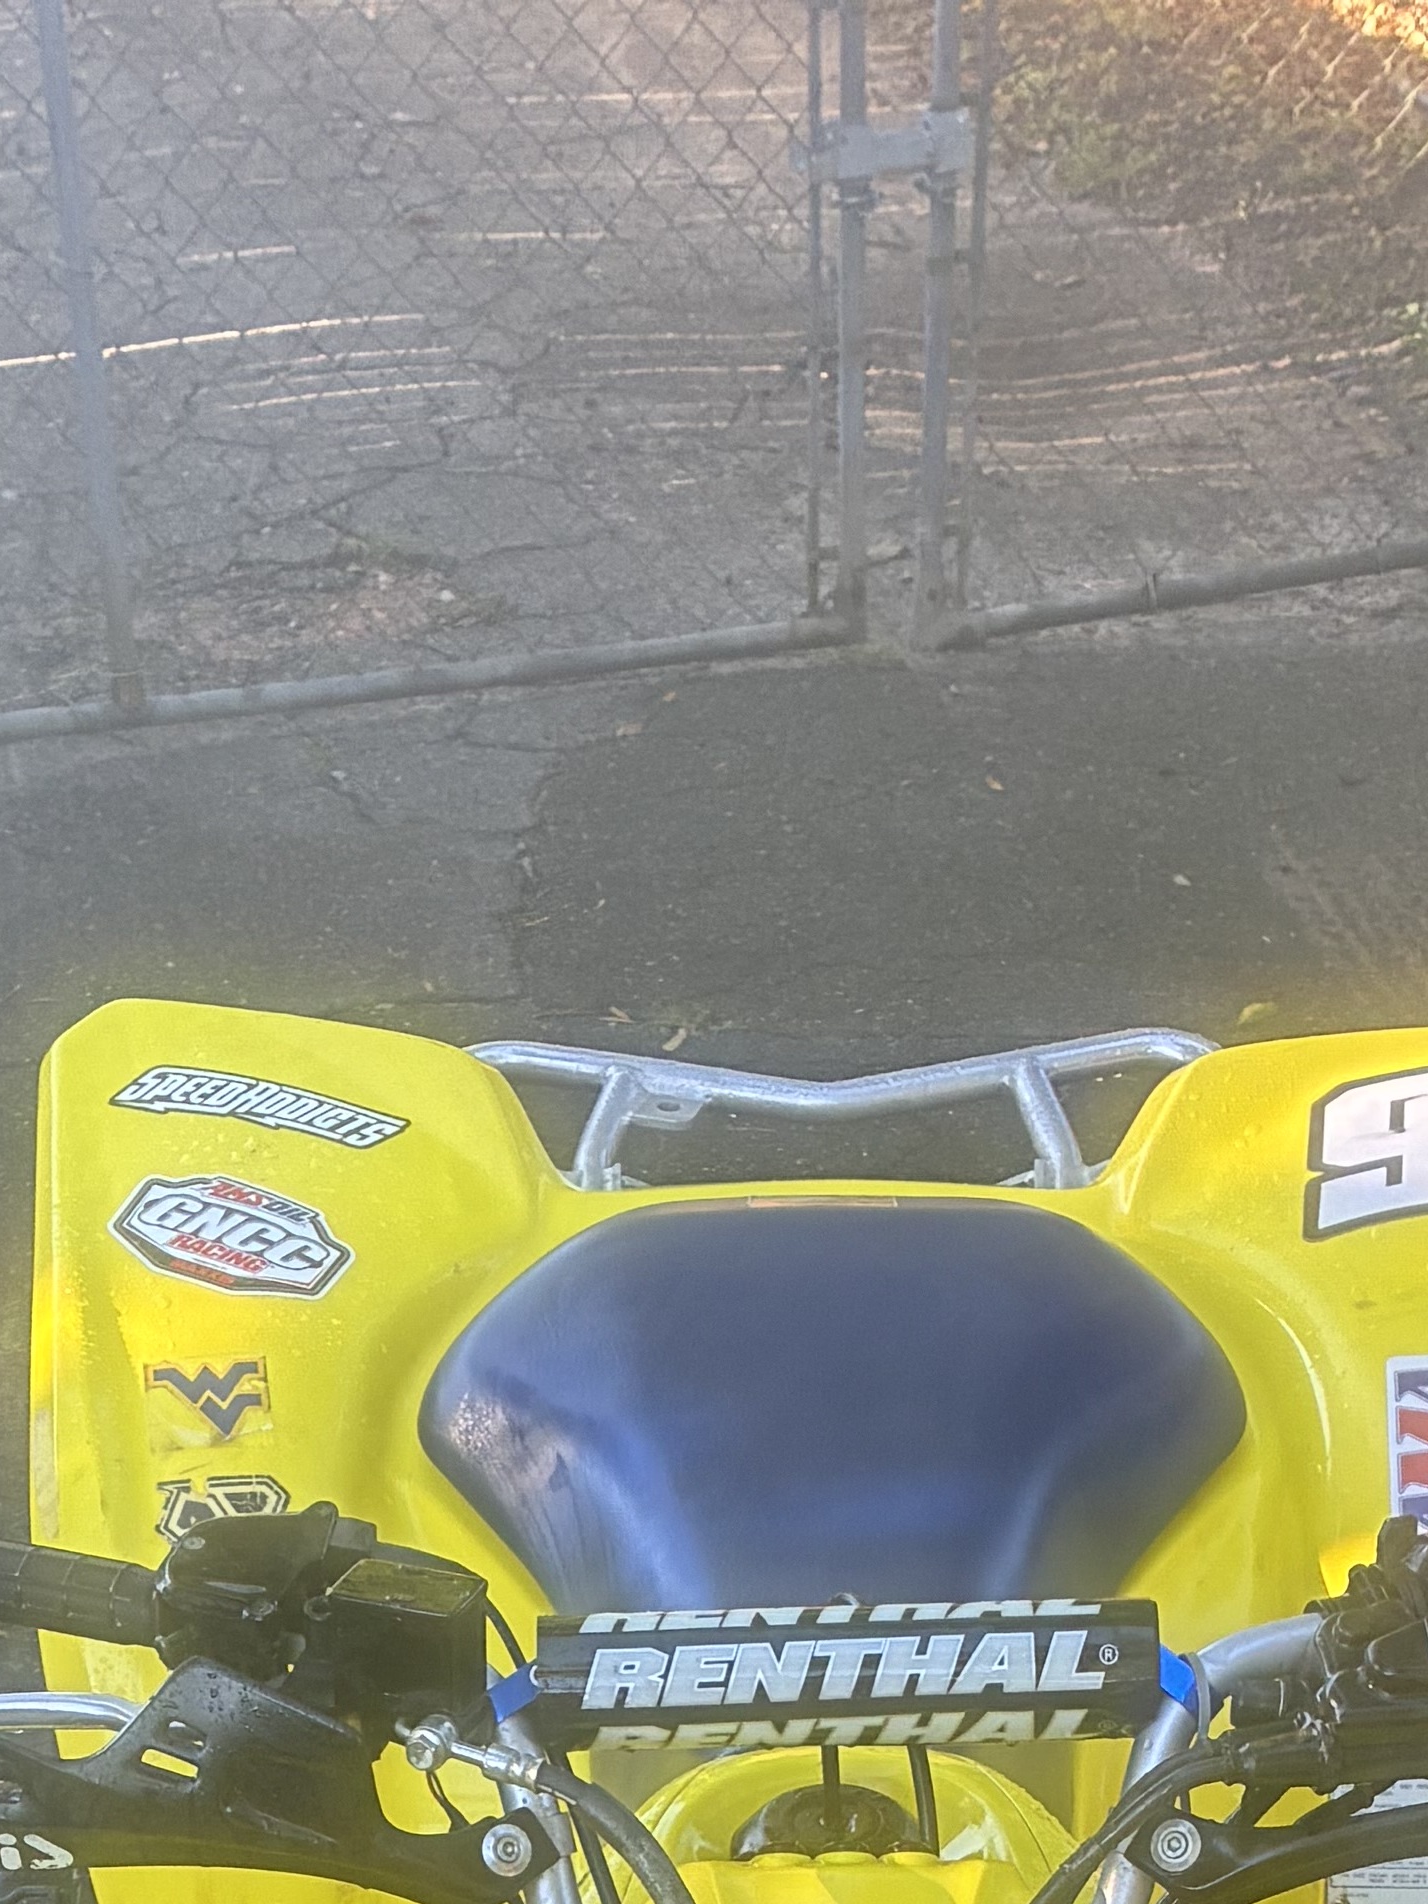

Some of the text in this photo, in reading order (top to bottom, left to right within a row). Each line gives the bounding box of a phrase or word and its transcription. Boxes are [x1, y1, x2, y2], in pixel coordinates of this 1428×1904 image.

[139, 1194, 331, 1270] GNCC
[167, 1234, 270, 1274] RACING
[581, 1629, 1107, 1710] RENTHAL
